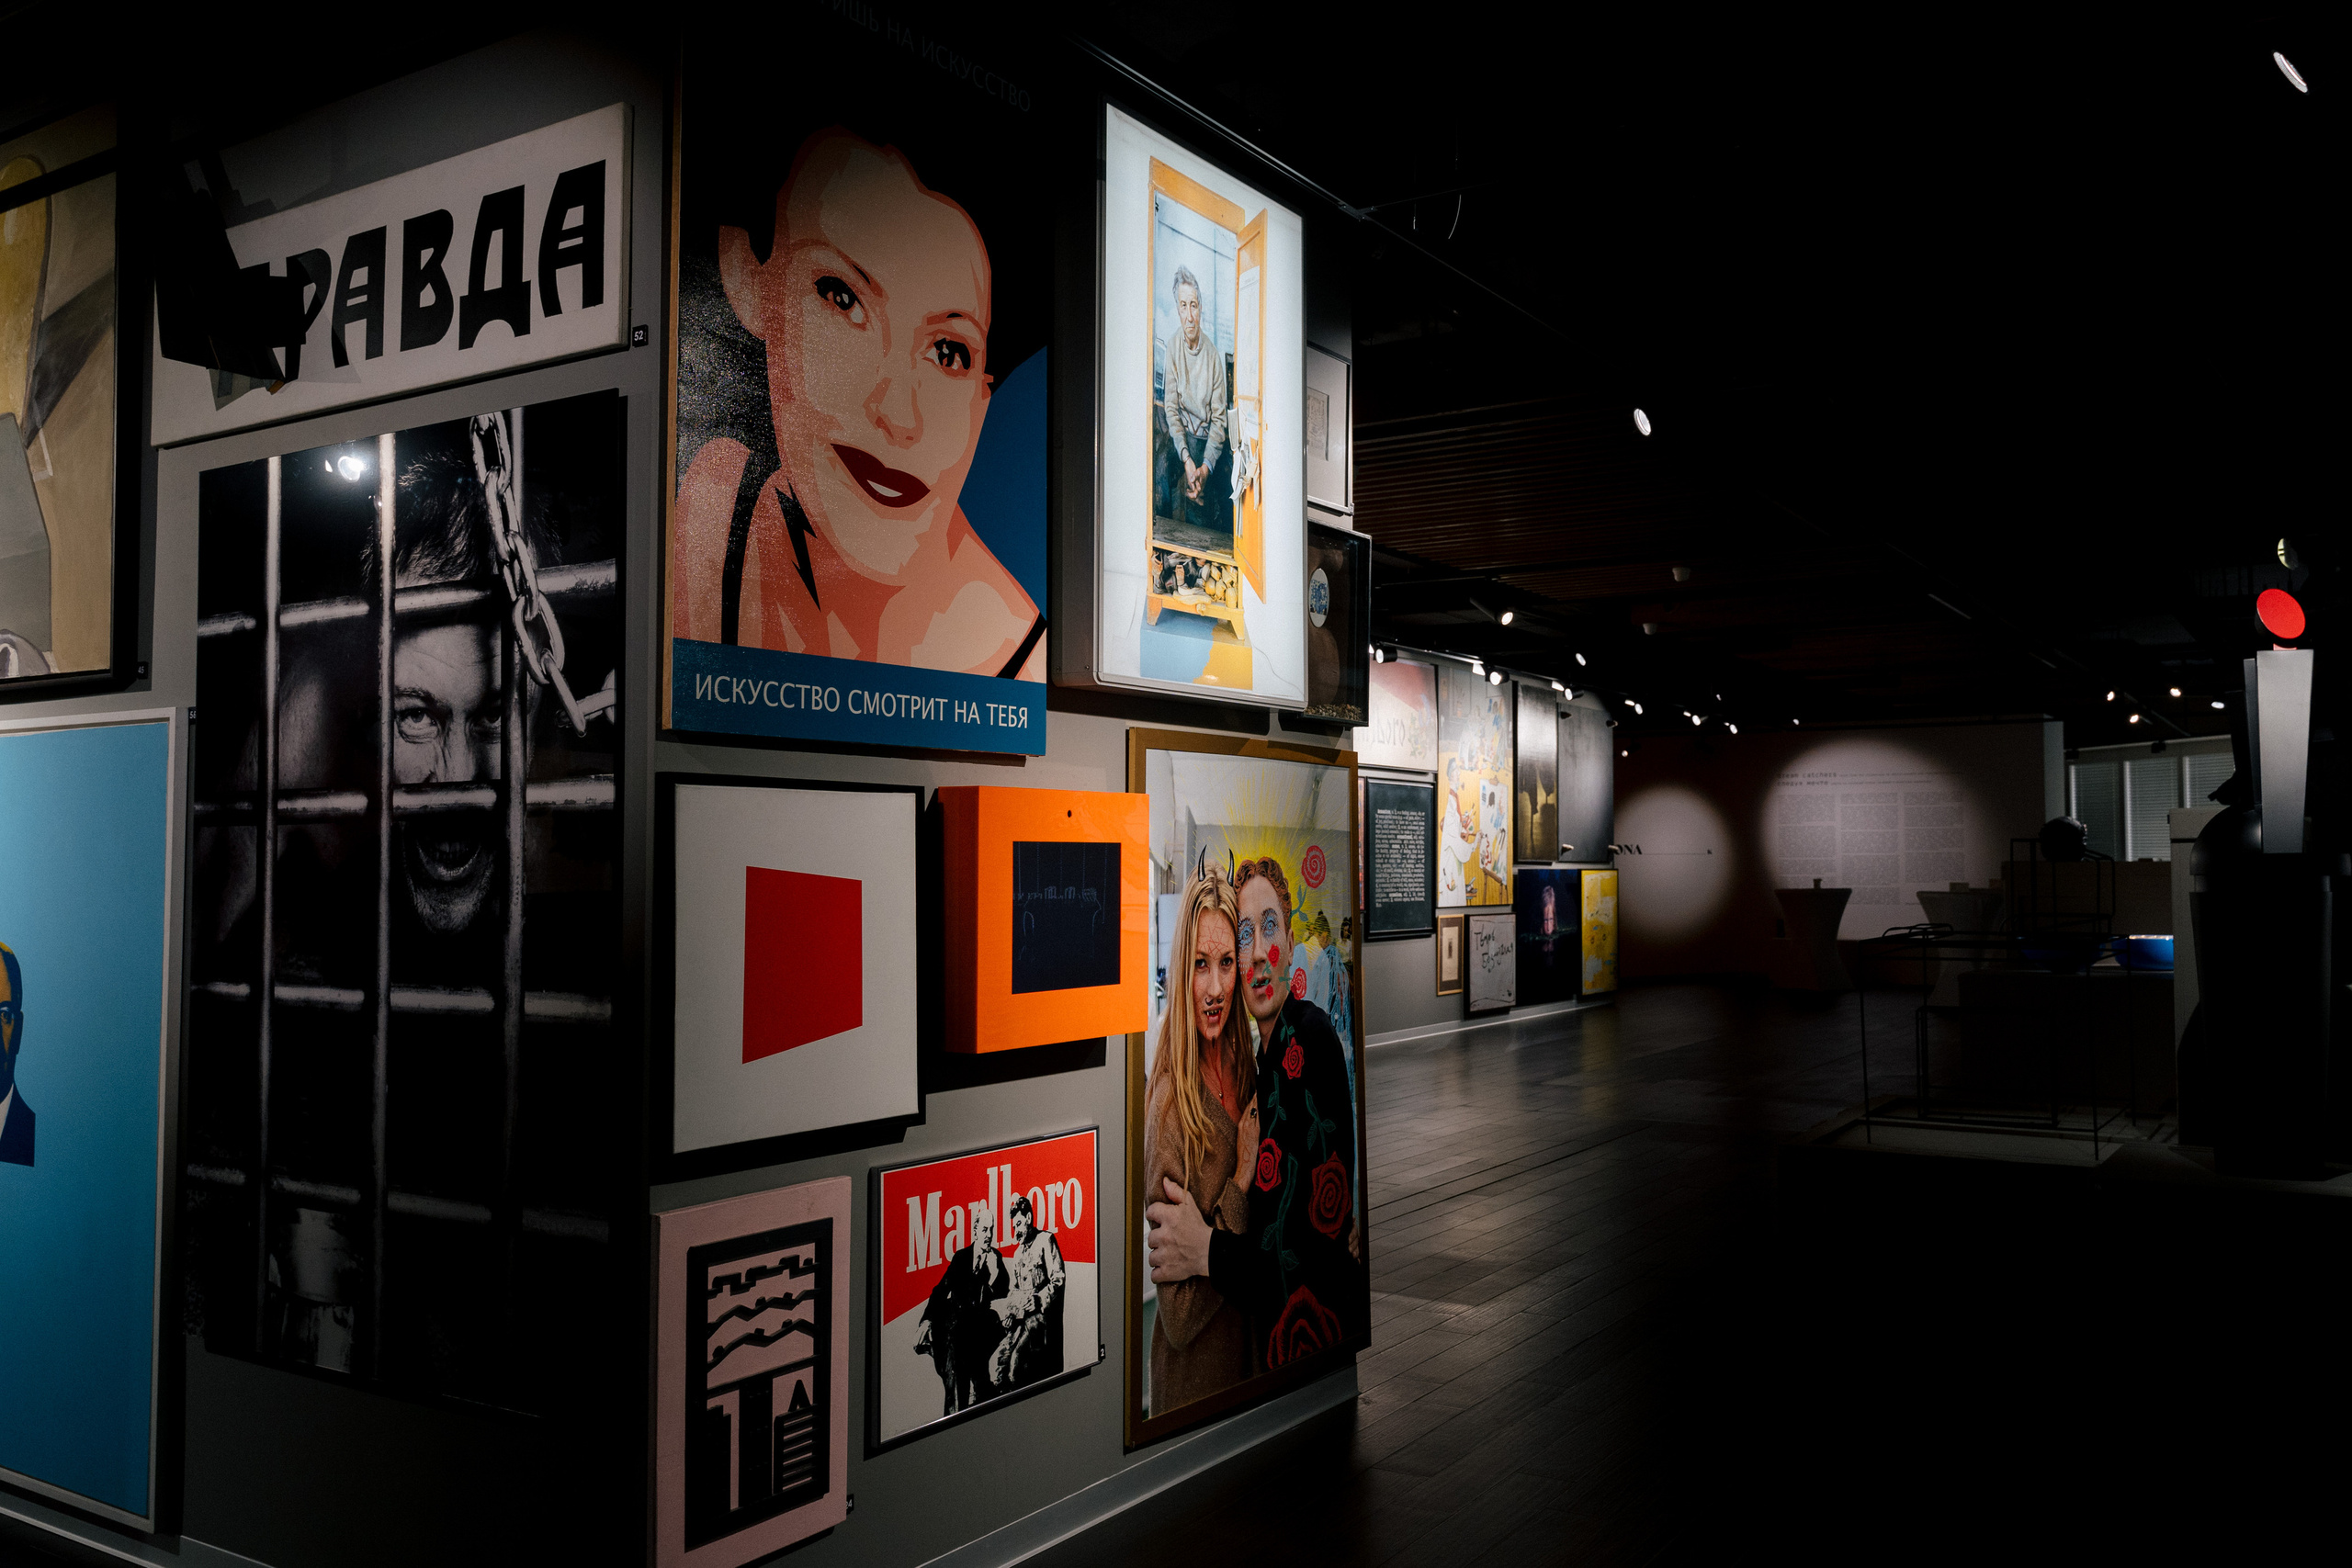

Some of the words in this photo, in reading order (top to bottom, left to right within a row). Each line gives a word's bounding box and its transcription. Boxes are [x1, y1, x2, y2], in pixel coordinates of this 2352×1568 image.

[820, 0, 879, 32] ИШЬ
[887, 16, 914, 52] НА
[921, 35, 1032, 112] ИСКУССТВО
[213, 160, 606, 399] РАВДА
[634, 330, 644, 342] 52
[695, 673, 841, 712] ИСКУССТВО
[847, 689, 948, 722] СМОТРИТ
[954, 699, 981, 725] НА
[986, 704, 1029, 728] ТЕБЯ
